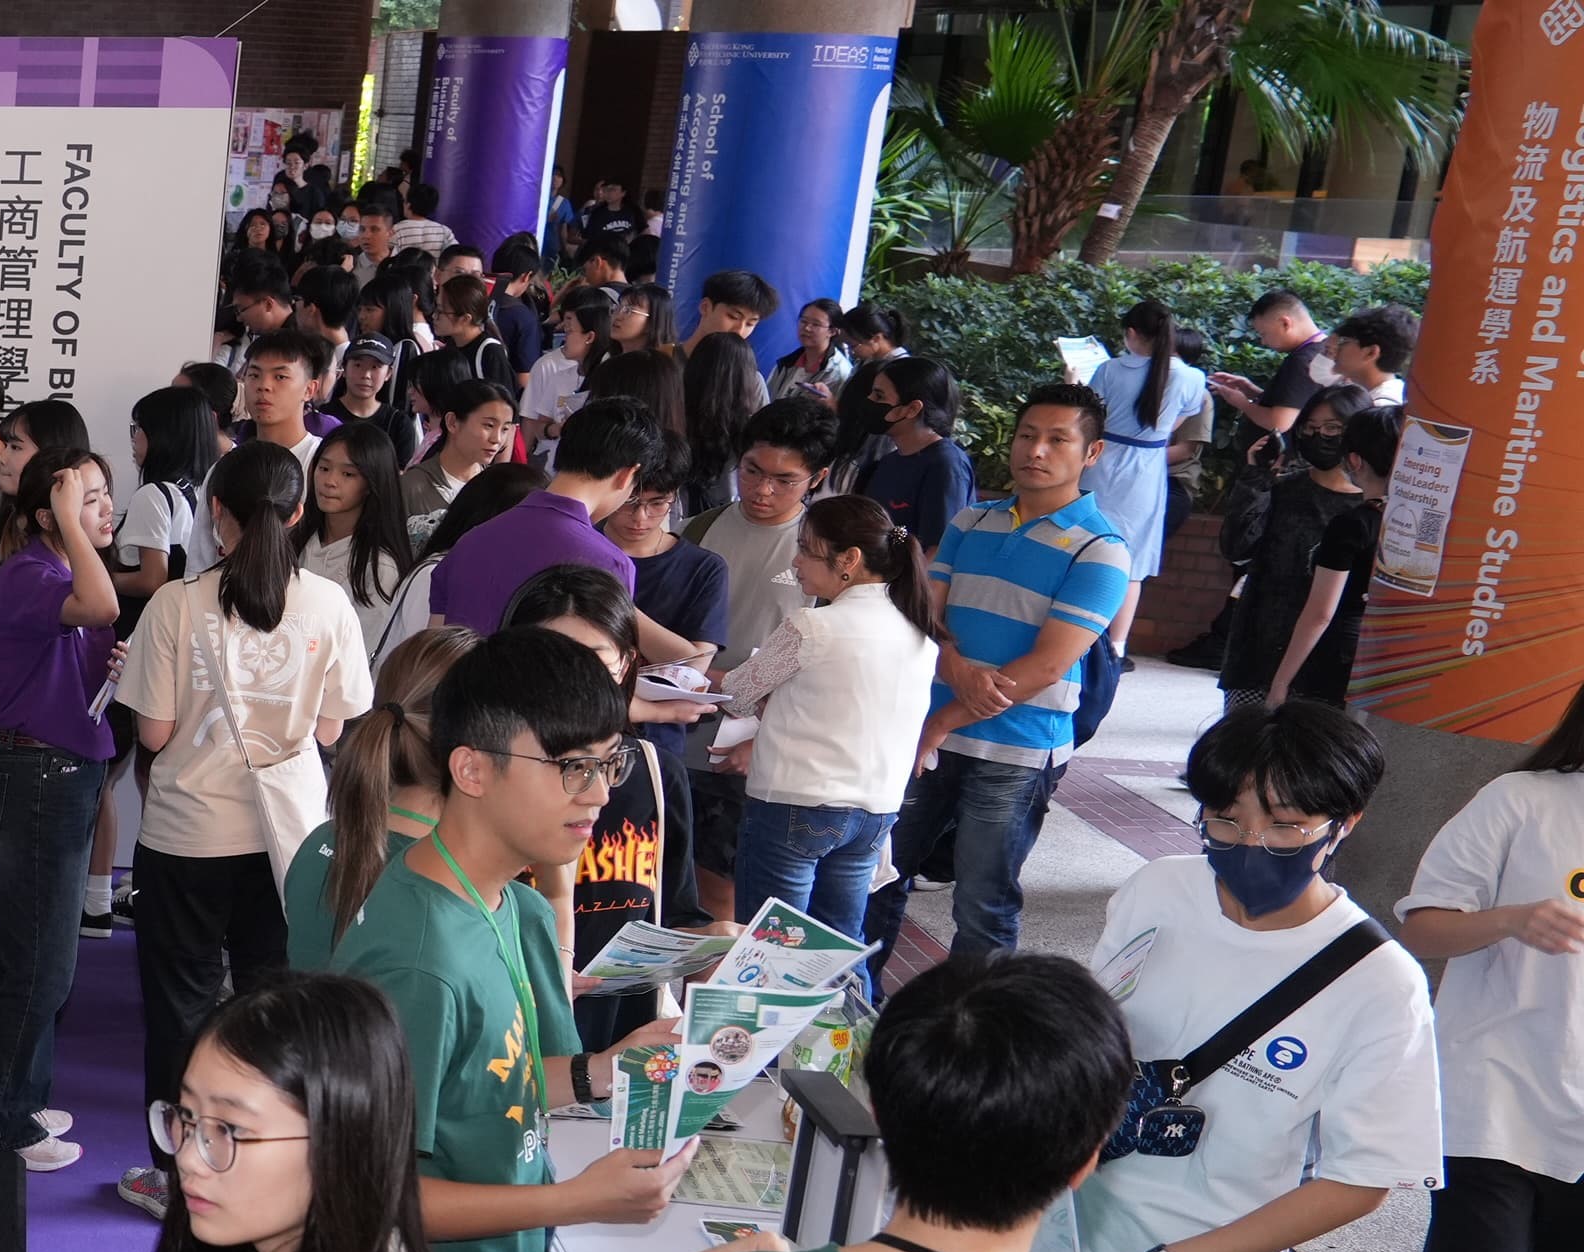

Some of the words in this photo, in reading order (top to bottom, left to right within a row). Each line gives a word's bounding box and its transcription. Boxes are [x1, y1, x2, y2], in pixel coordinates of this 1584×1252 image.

[742, 51, 791, 59] UNIVERSITY
[812, 45, 869, 63] IDEAS
[437, 77, 450, 131] Business
[447, 77, 463, 124] Faculty
[704, 93, 726, 154] School
[447, 127, 457, 142] of
[680, 93, 707, 196] Accounting
[701, 160, 714, 181] of
[55, 143, 93, 300] FACULTY
[676, 203, 689, 236] and
[1469, 102, 1559, 385] 物流及航運學系
[1531, 275, 1567, 343] and
[51, 311, 80, 357] OF
[1493, 355, 1559, 517] Maritime
[1403, 457, 1442, 477] Emerging
[1412, 475, 1449, 494] Leaders
[1394, 486, 1439, 508] Scholarship
[1462, 527, 1519, 656] Studies
[575, 818, 657, 892] ASHE
[1238, 1060, 1263, 1076] BATHING
